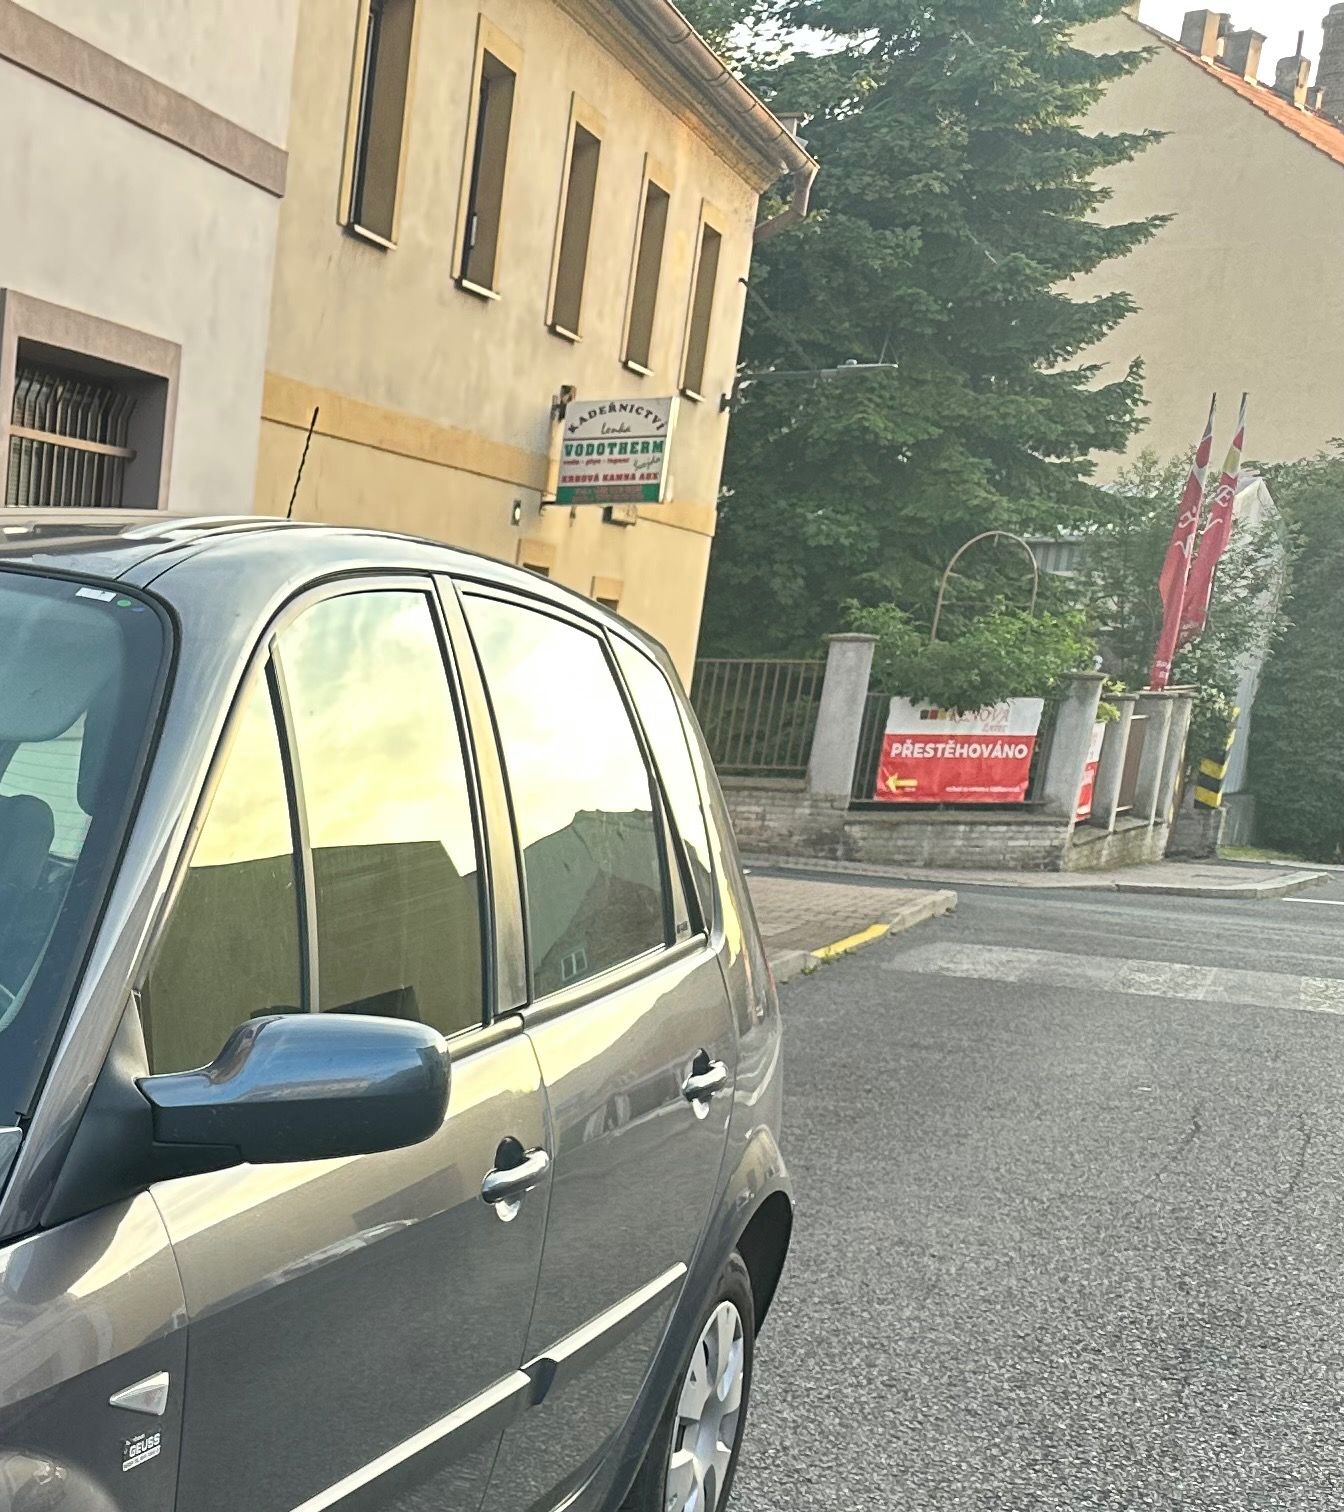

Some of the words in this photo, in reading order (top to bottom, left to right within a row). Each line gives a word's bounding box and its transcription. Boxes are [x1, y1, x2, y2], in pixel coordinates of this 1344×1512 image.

[568, 402, 665, 434] KADEŘNICTVÍ
[565, 441, 664, 456] VODOTHERM
[602, 472, 636, 481] KAMNA
[890, 739, 1029, 759] PŘESTĚHOVÁNO
